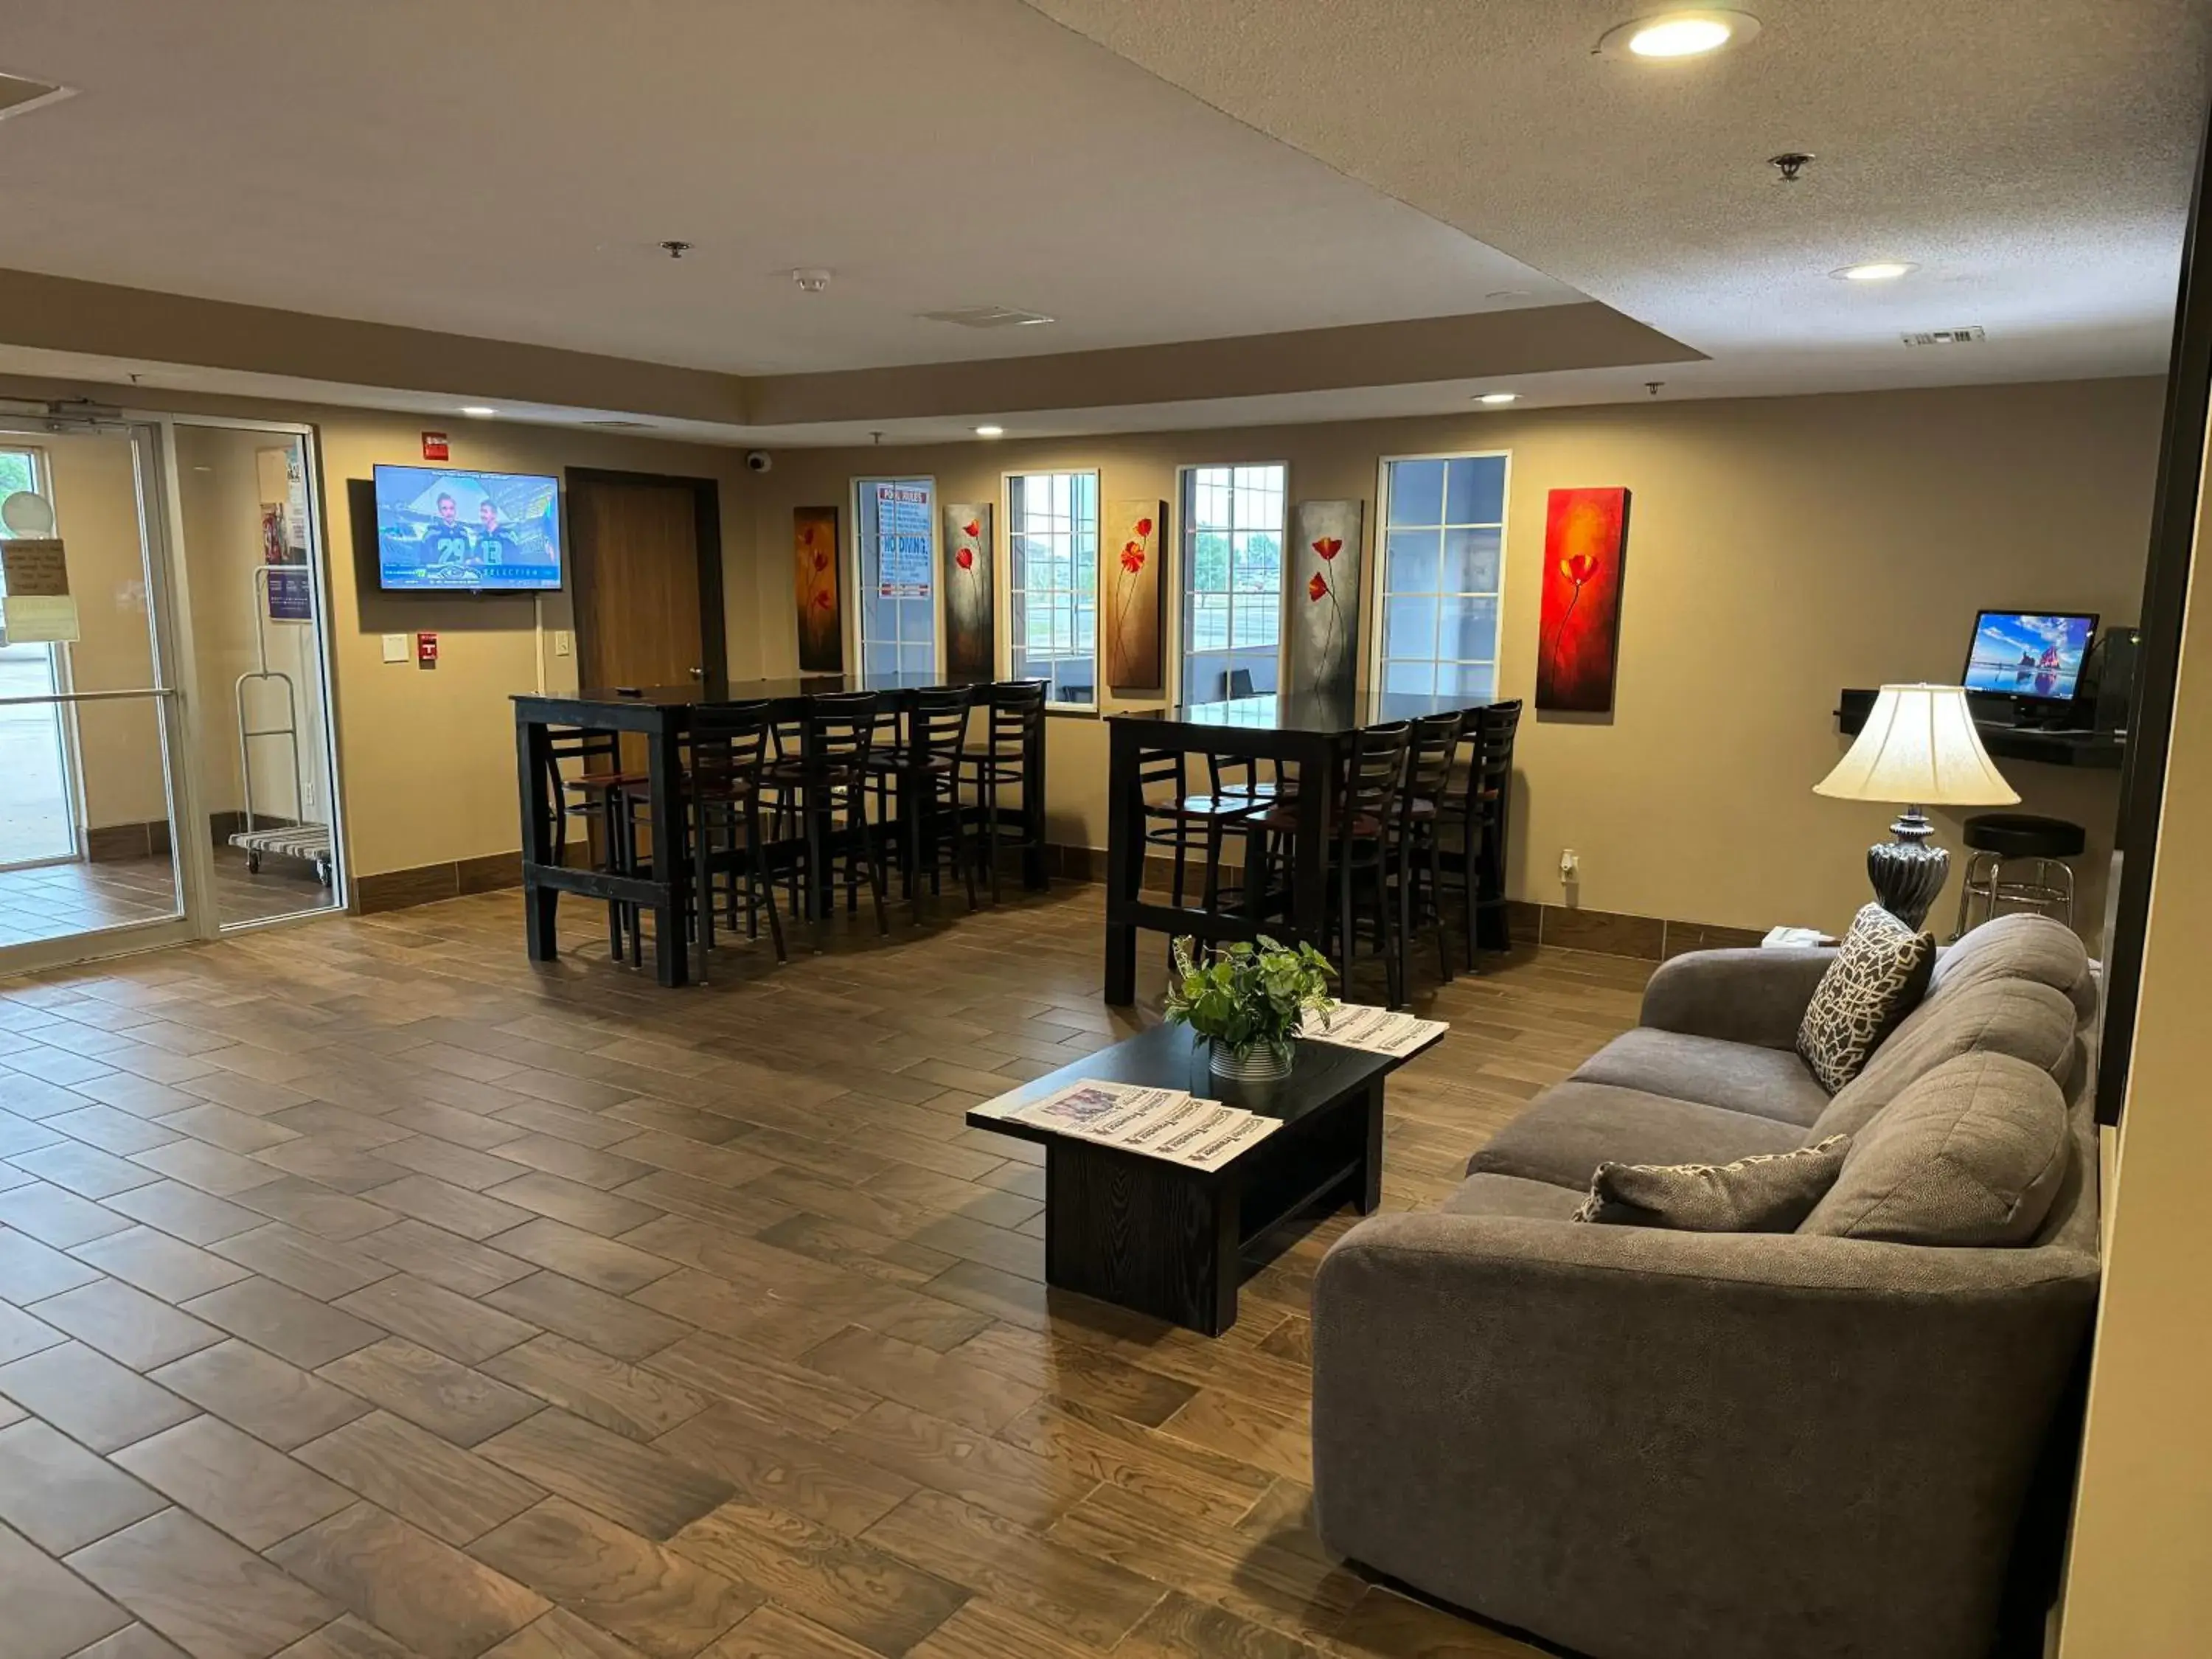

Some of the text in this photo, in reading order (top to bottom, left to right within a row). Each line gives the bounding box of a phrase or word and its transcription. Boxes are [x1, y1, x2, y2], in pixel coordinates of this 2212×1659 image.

[437, 538, 503, 566] 29 13
[884, 535, 895, 552] NO
